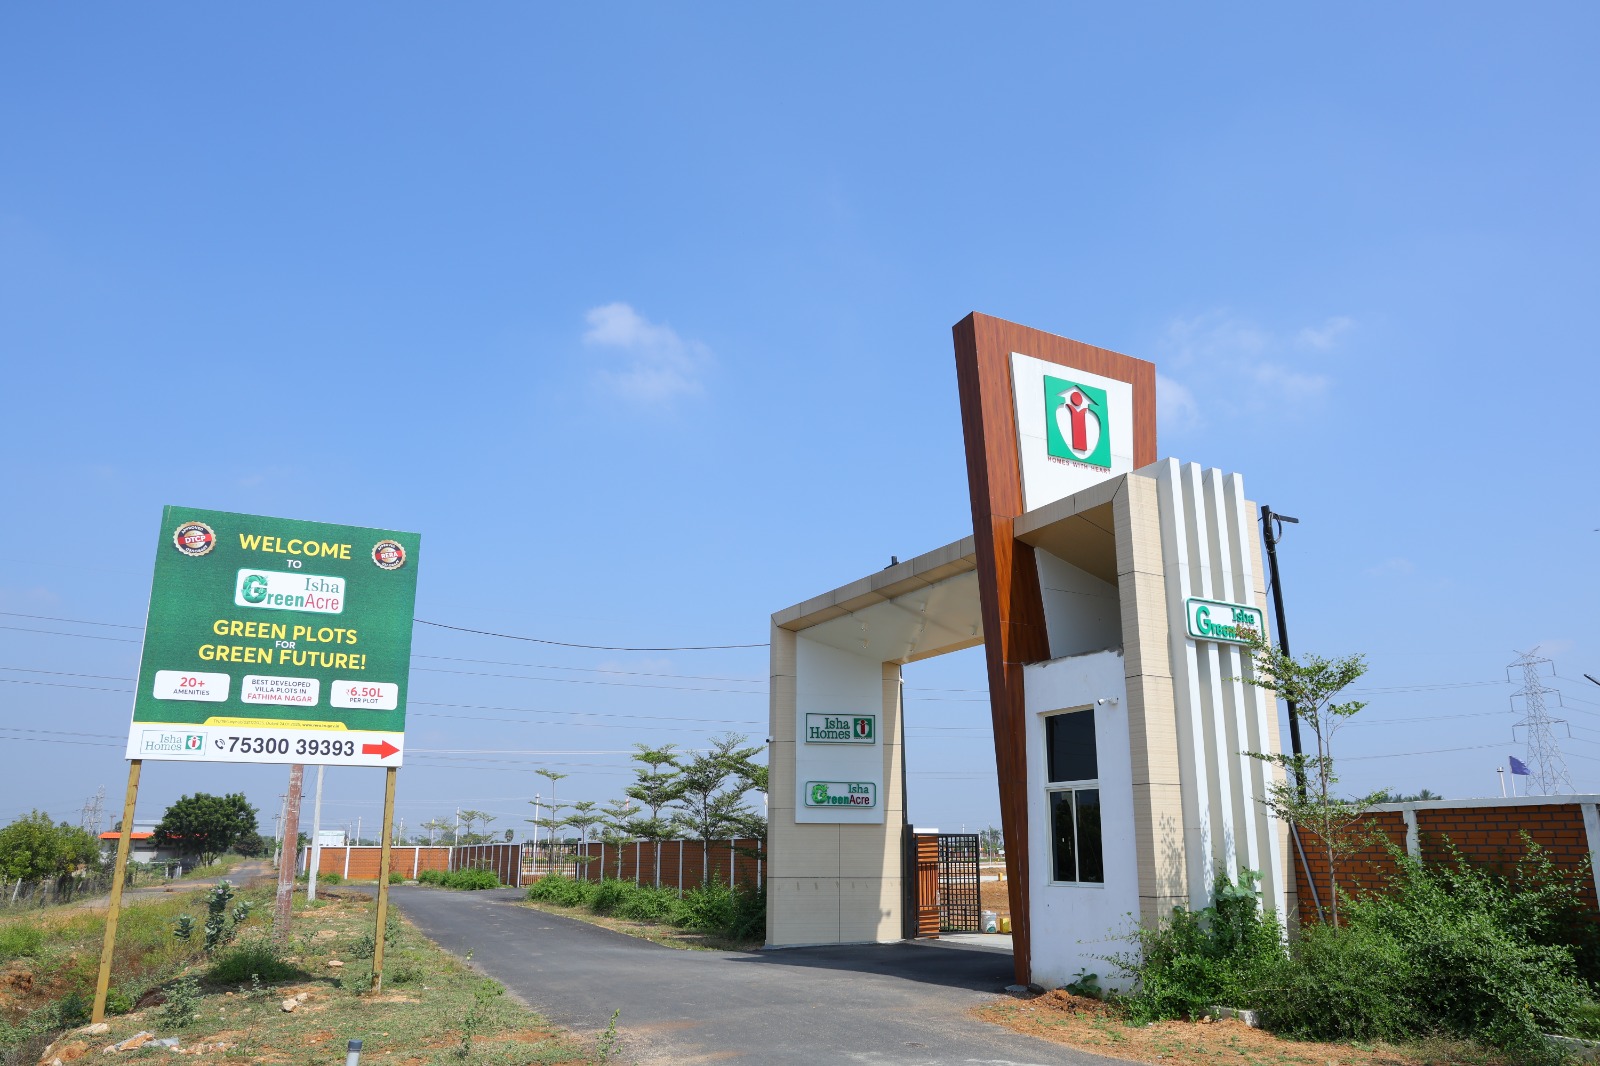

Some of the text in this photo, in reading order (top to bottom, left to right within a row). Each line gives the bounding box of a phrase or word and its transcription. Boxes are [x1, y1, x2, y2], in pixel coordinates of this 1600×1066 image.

[1047, 456, 1111, 475] HOMES WITH HEART
[184, 535, 206, 544] DTCP
[239, 533, 352, 560] WELCOME
[286, 559, 302, 569] TO
[304, 577, 340, 594] Isha
[241, 574, 339, 611] GreenAcre
[213, 619, 358, 645] GREEN PLOTS
[275, 640, 296, 650] FOR
[198, 644, 367, 670] GREEN FUTURE!
[180, 676, 205, 688] 20+
[251, 678, 311, 688] BEST DEVELOPED
[173, 688, 210, 696] AMENITIES
[255, 686, 274, 694] VILLA
[247, 692, 312, 703] FATHIMA NAGAR
[825, 717, 851, 730] Isha
[160, 733, 182, 744] Isha
[809, 726, 851, 739] Homes
[145, 741, 182, 751] Homes
[228, 736, 355, 757] 75300 39393
[811, 783, 870, 805] GreenAcre
[848, 783, 870, 794] Isha
